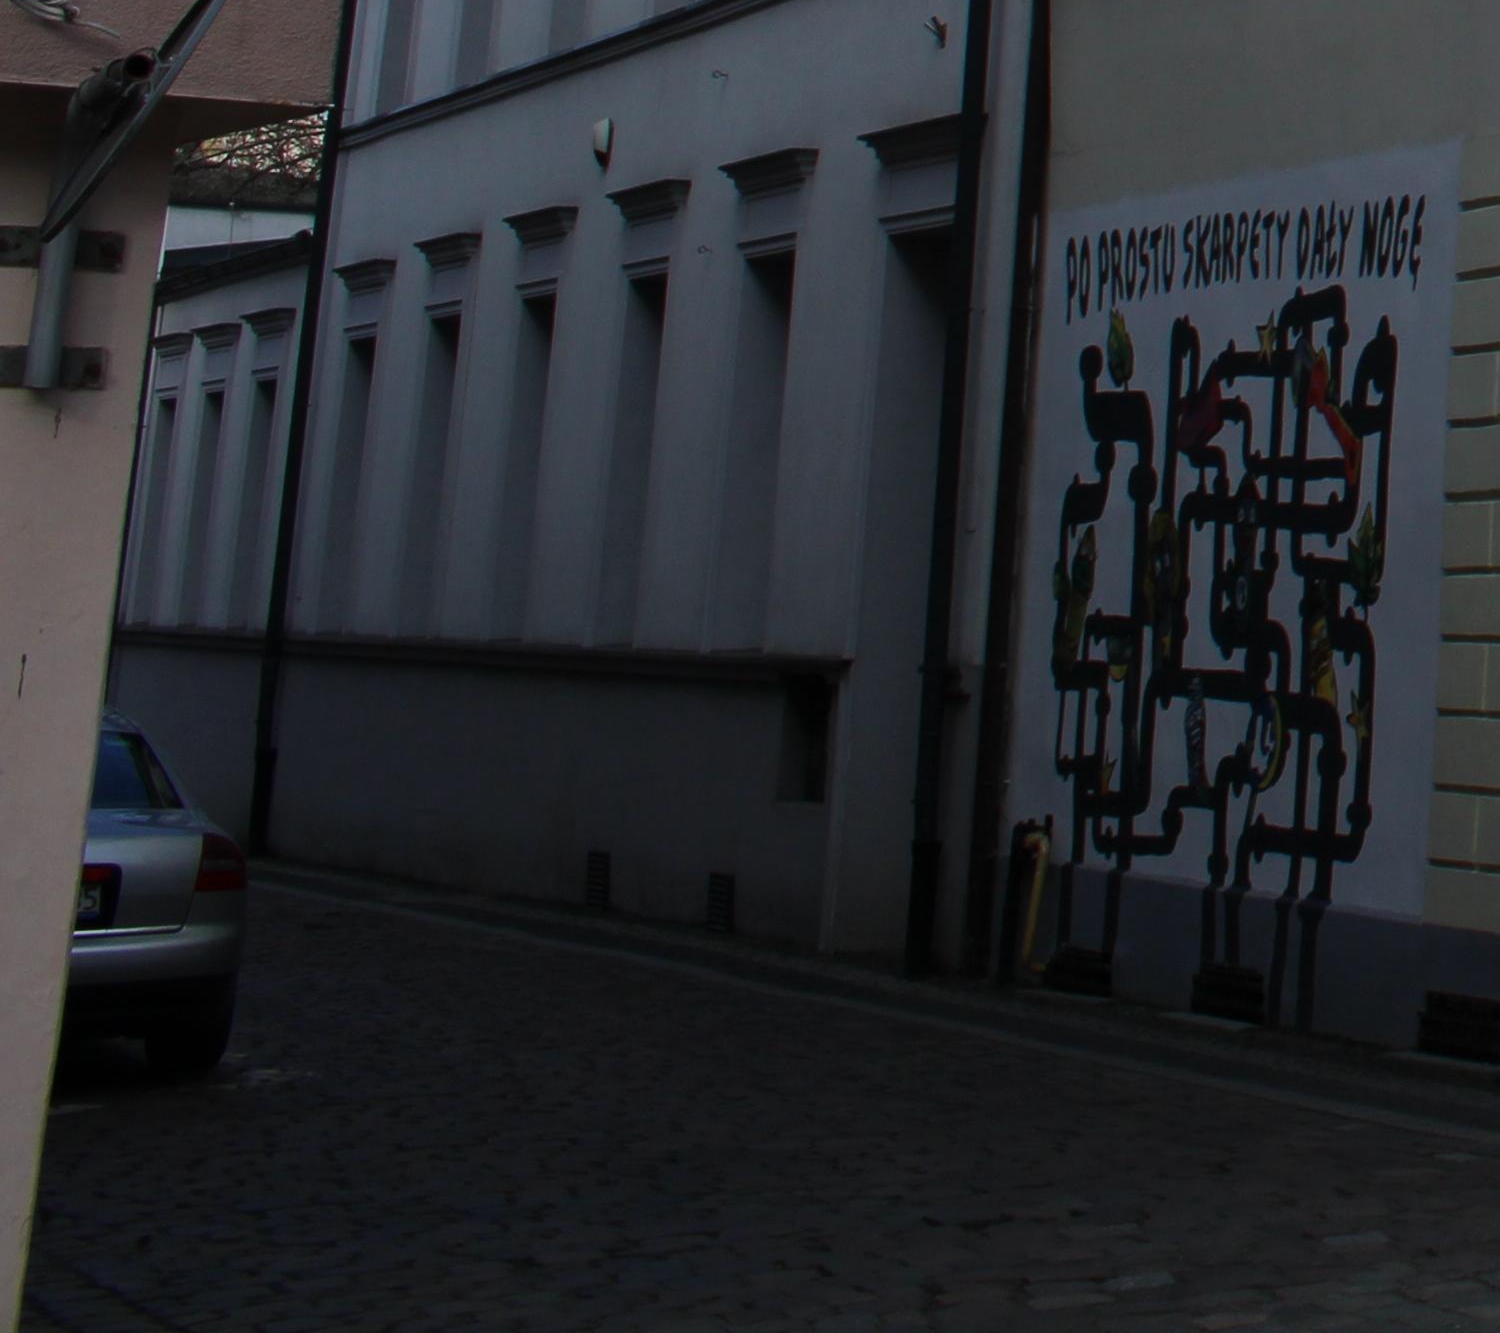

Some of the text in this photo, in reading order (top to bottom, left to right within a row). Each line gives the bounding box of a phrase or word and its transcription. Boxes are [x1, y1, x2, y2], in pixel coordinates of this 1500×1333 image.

[1065, 193, 1426, 326] PO PROSTU SKARPETY DAŁY NOGĘ
